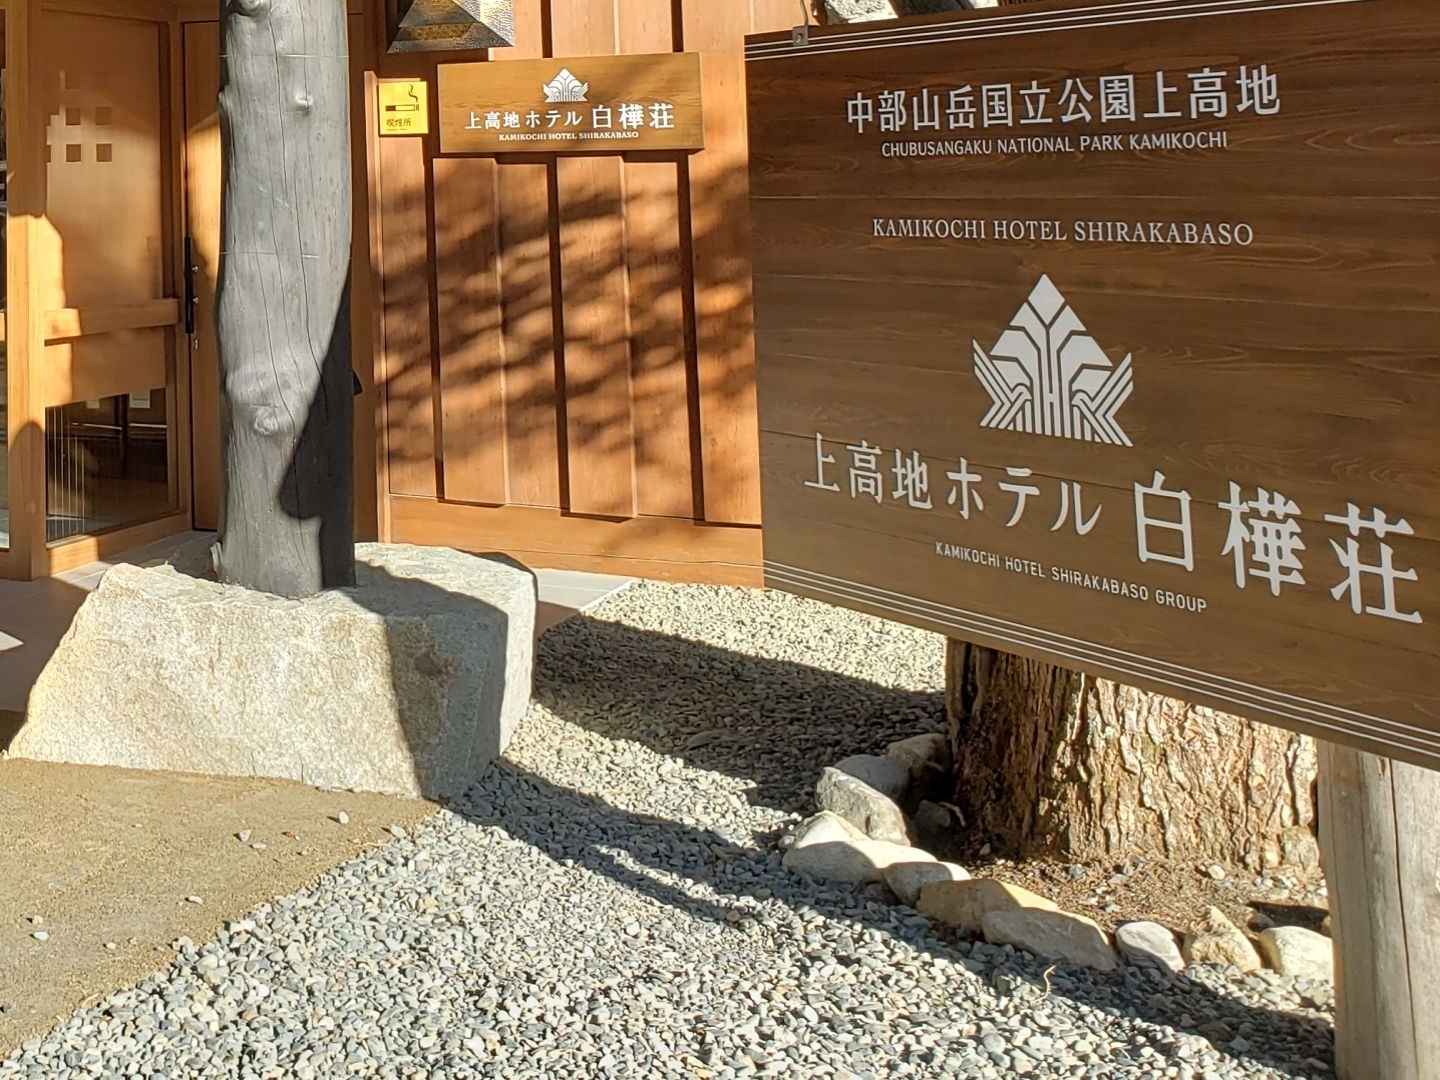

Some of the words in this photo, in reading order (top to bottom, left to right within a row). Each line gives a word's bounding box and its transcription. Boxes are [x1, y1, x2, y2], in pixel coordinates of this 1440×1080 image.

[846, 64, 1281, 134] 中部山岳国立公園上高地
[386, 118, 412, 127] 喫煙所
[498, 132, 547, 141] KAMIKOCHI
[548, 132, 578, 140] HOTEL
[578, 131, 639, 139] SHIRAKABASO
[881, 139, 992, 158] CHUBUSANGAKU
[997, 136, 1074, 154] NATIONAL
[1080, 134, 1124, 151] PARK
[1129, 131, 1228, 150] KAMIKOCHI
[872, 218, 986, 239] KAMIKOCHI
[993, 219, 1067, 241] HOTEL
[1074, 221, 1254, 246] SHIRAKABASO
[935, 541, 1000, 568] KAMIKOCHI
[1005, 556, 1046, 578] HOTEL
[1051, 566, 1149, 601] SHIRAKABASO
[1155, 589, 1207, 613] GROUP
